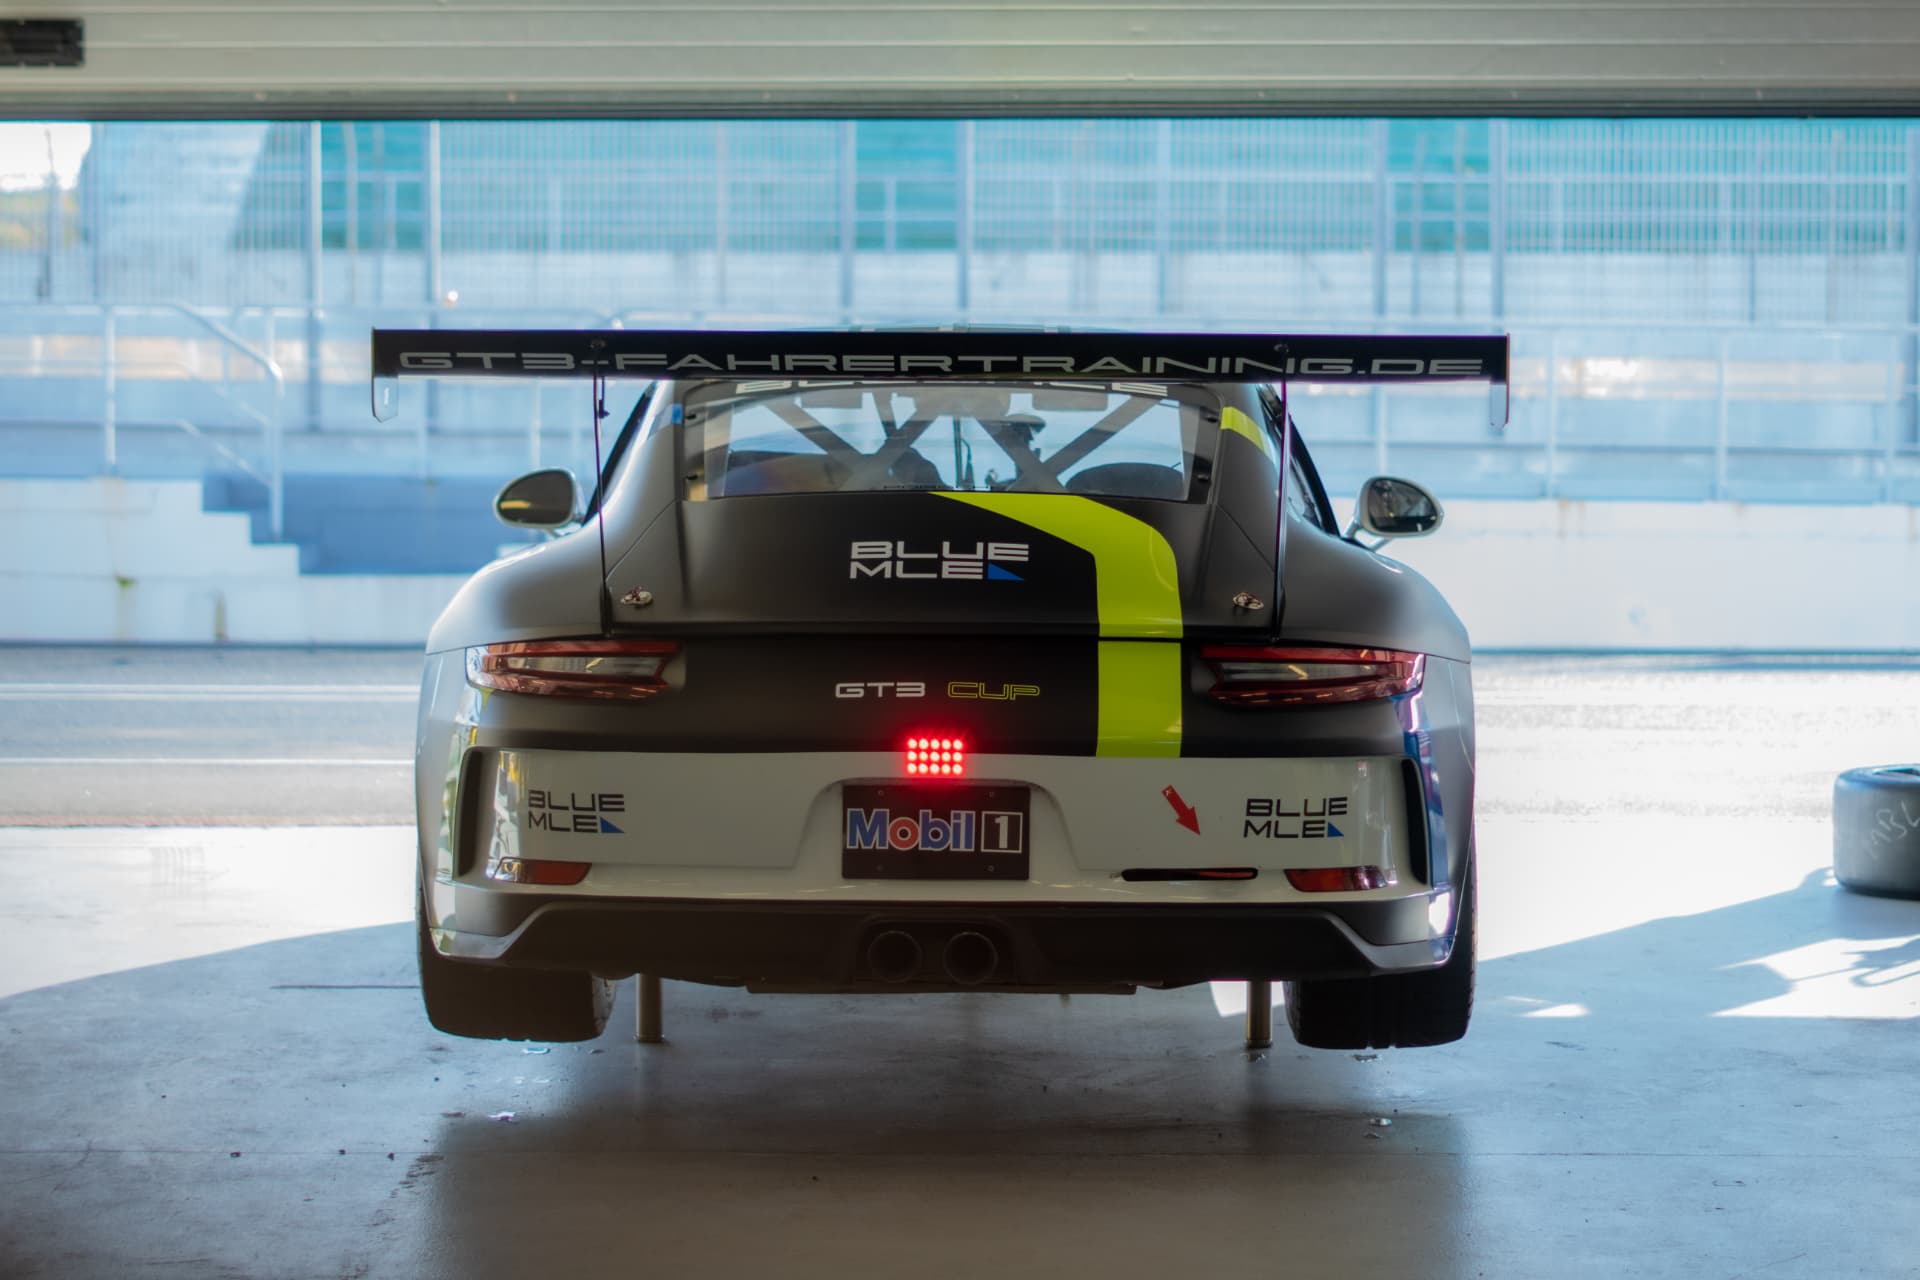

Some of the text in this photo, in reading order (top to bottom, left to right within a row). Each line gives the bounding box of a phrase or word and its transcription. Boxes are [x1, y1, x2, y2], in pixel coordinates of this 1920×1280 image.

[851, 540, 1029, 562] BLUE
[849, 560, 984, 580] MLE
[834, 681, 1041, 701] GT3 CUP
[528, 789, 626, 812] BLUE
[1246, 796, 1348, 817] BLUE
[528, 810, 599, 833] MLE
[846, 807, 976, 852] Mobil
[1243, 819, 1326, 839] MLE
